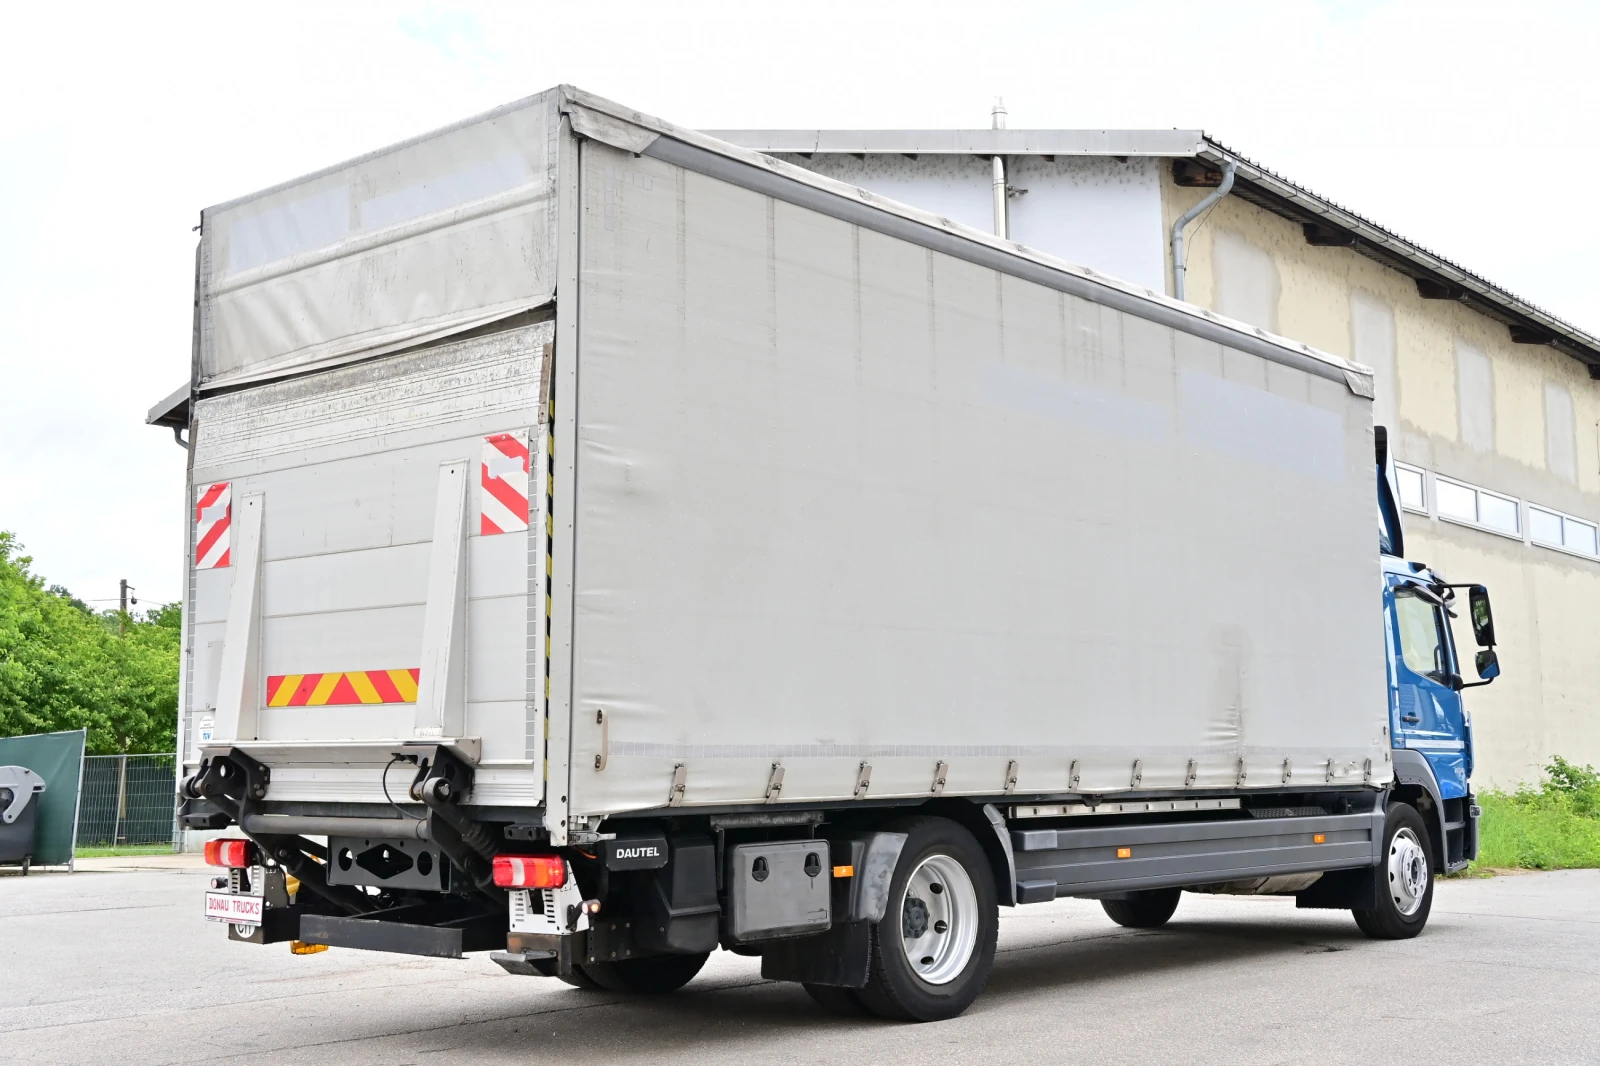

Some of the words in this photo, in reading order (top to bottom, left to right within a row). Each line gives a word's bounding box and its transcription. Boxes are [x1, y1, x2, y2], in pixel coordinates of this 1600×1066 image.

[616, 846, 660, 859] DAUTEL
[209, 898, 229, 911] DONAU
[232, 900, 260, 914] TRUCKS
